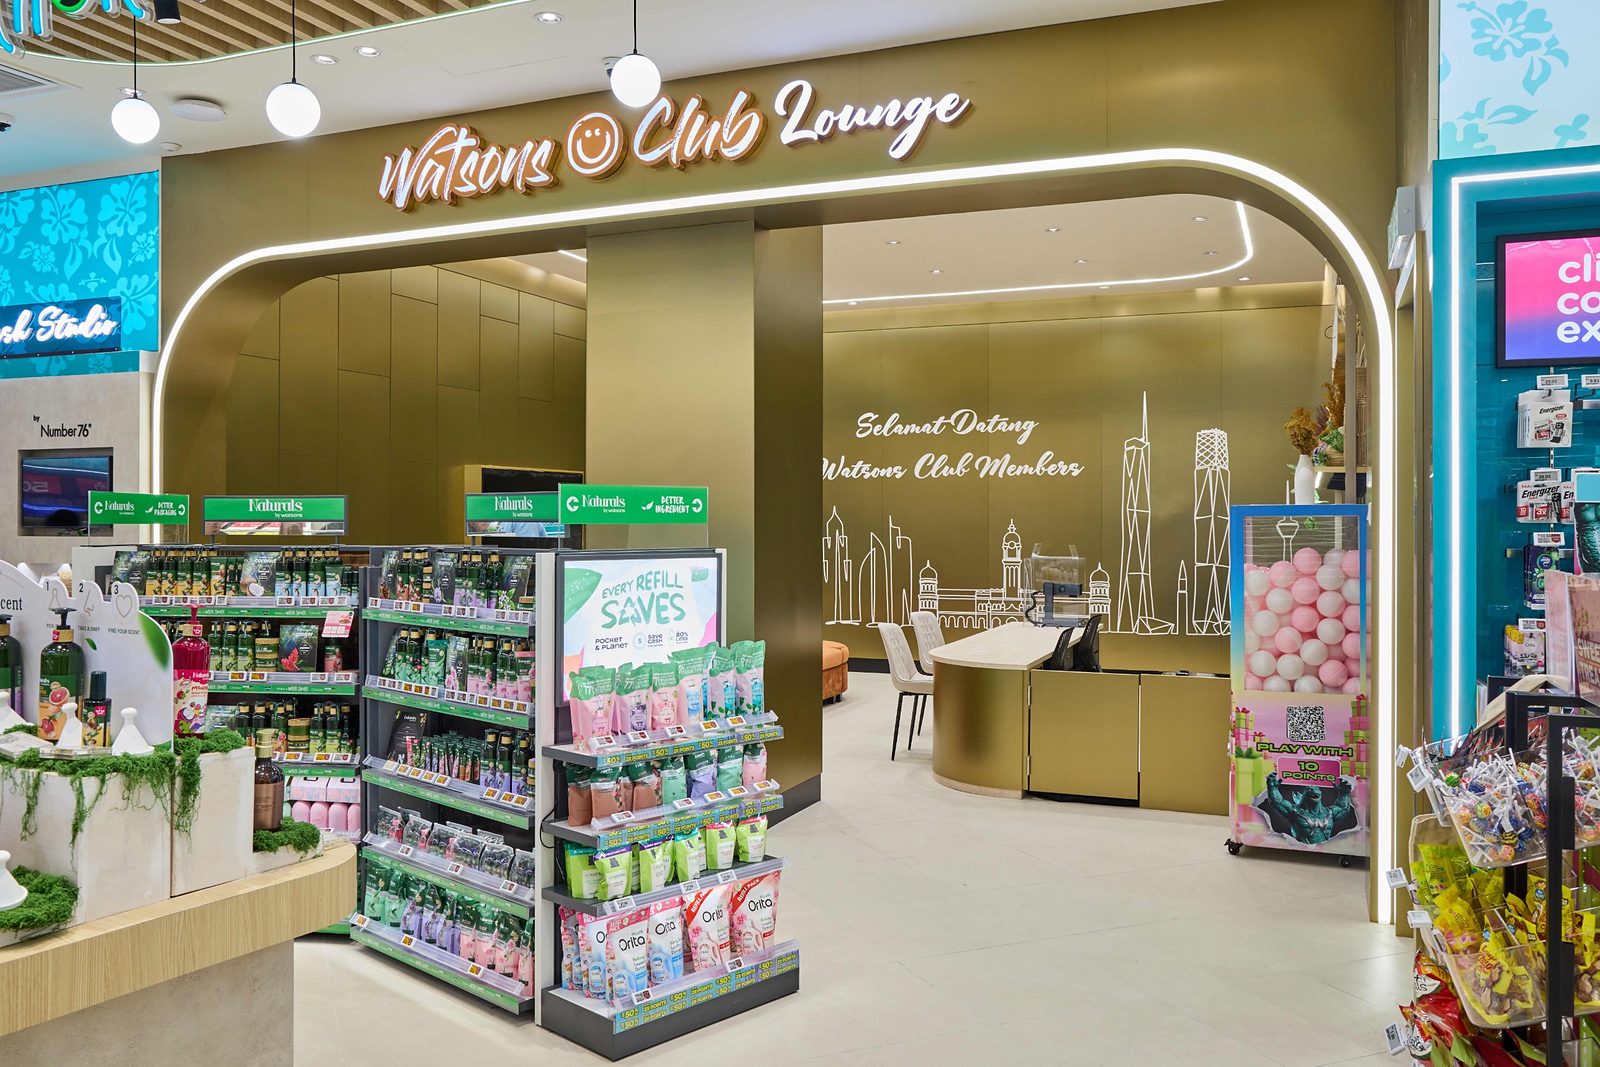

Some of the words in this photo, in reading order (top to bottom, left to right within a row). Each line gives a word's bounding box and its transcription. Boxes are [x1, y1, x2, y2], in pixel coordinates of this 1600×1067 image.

[379, 125, 556, 209] Watsons
[632, 88, 762, 168] Club
[774, 79, 970, 160] Lounge
[36, 304, 118, 342] Studio
[1539, 405, 1565, 414] Energizer
[33, 415, 40, 423] by
[856, 412, 951, 439] Selamat
[950, 408, 1039, 446] Datang
[821, 455, 908, 481] Watsons
[914, 452, 971, 479] Club
[975, 450, 1085, 479] Members
[1521, 485, 1560, 499] Energizer
[105, 500, 135, 511] Naturals
[248, 498, 303, 512] Naturals
[494, 496, 533, 511] Naturals
[582, 494, 626, 508] Naturals
[79, 583, 84, 593] 2
[114, 585, 119, 594] 3
[602, 579, 634, 599] EVERY
[636, 570, 684, 592] REFILL
[1256, 742, 1301, 754] PLAY
[1302, 745, 1354, 757] WITH
[1299, 760, 1320, 772] 10
[1282, 771, 1336, 782] POINTS
[748, 898, 773, 912] Orita
[619, 936, 646, 951] Orita
